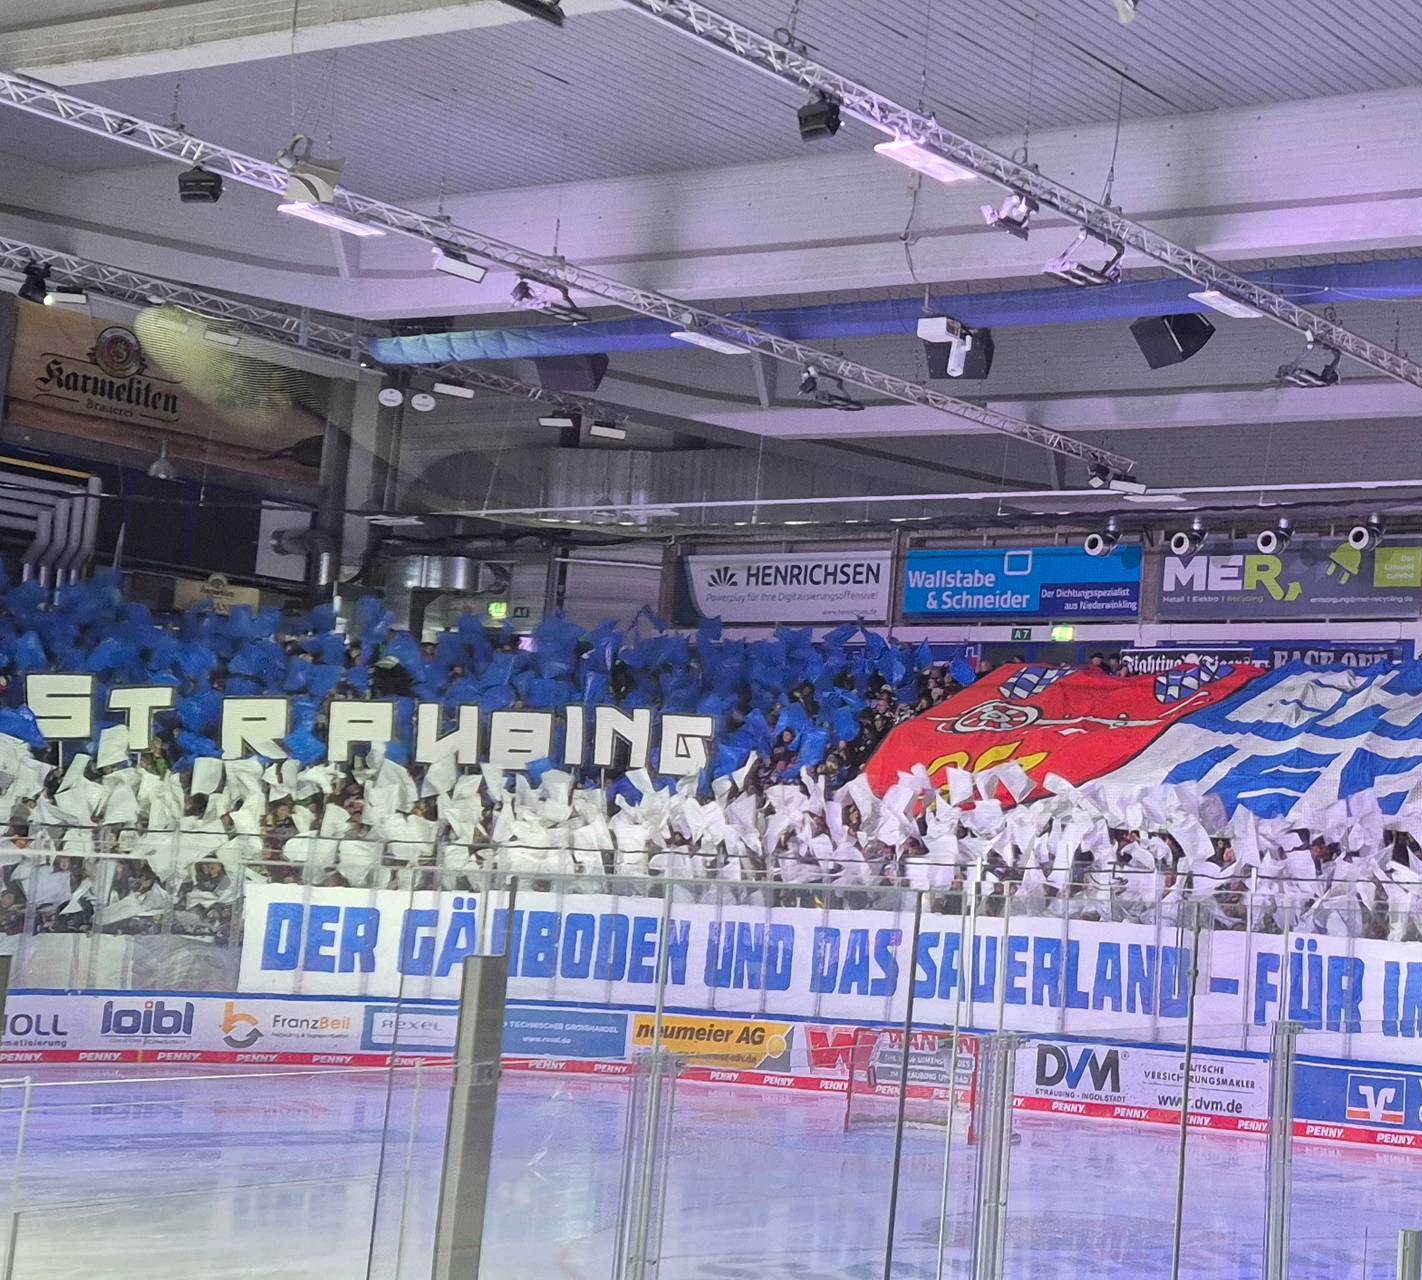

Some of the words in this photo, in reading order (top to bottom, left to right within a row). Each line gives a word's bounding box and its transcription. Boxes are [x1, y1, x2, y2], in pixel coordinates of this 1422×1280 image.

[35, 359, 178, 413] Karmeliten
[745, 563, 881, 587] HENRICHSEN
[908, 569, 996, 588] Wallstabe
[1163, 554, 1285, 601] MER
[926, 591, 938, 610] &
[941, 590, 1030, 609] Schneider
[1041, 588, 1055, 599] Der
[1056, 587, 1130, 599] Dichtungsspezialist
[1064, 601, 1079, 611] aus
[1080, 599, 1137, 612] Niederwinkling
[260, 902, 381, 973] DER
[707, 919, 796, 991] UND
[808, 926, 900, 997] DAS
[914, 931, 1190, 1019] SAUERLAND
[1254, 937, 1365, 1034] FÜR
[100, 1000, 194, 1035] loibl
[272, 1014, 350, 1030] FranzBeil
[736, 1026, 765, 1045] AG
[1035, 1043, 1121, 1093] DVM
[1081, 1092, 1126, 1103] INGOLSTADT
